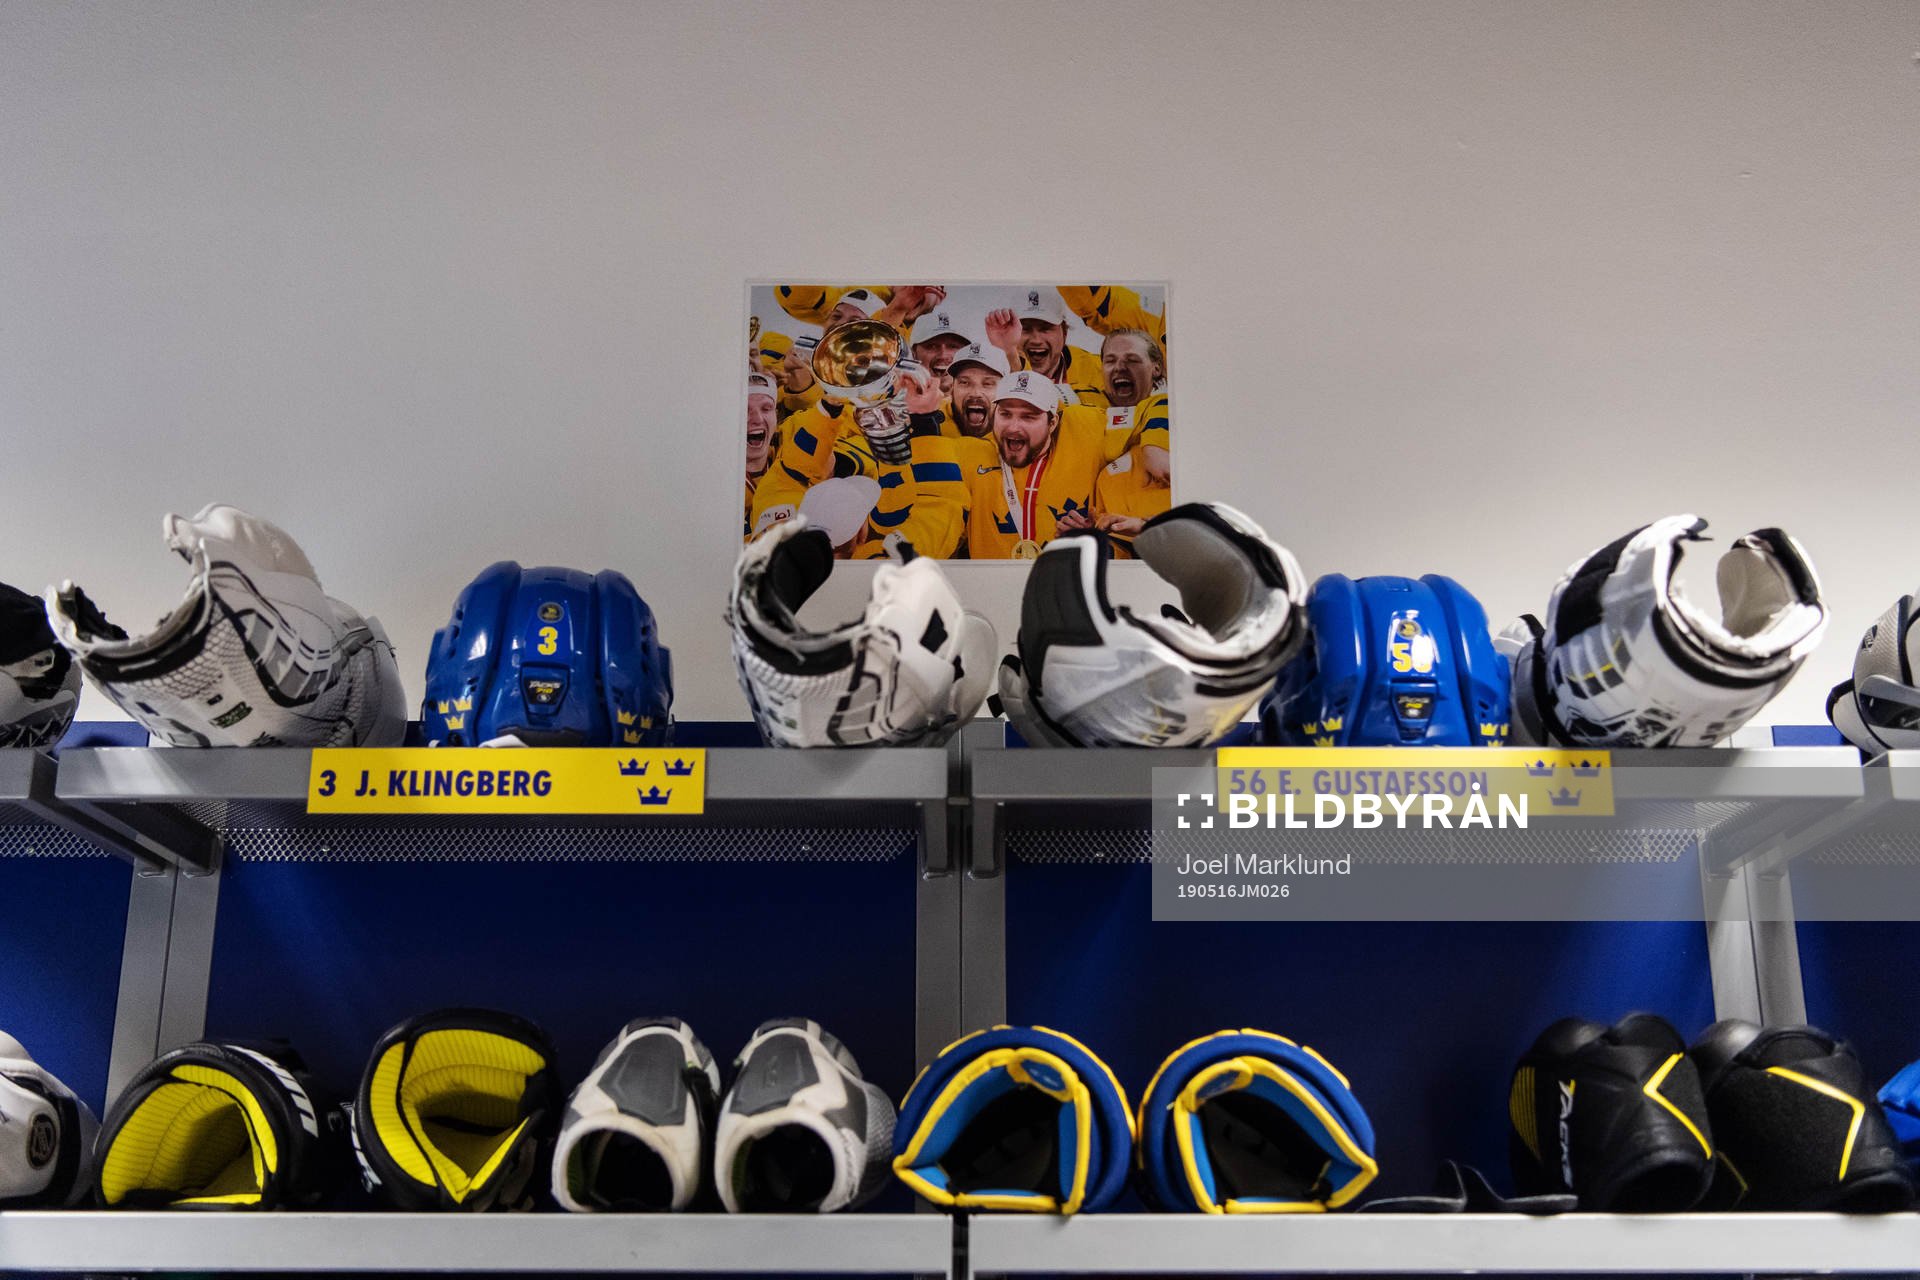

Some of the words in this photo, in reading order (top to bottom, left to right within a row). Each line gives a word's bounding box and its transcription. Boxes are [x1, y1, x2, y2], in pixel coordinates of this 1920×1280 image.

[538, 627, 558, 655] 3
[1393, 640, 1434, 673] 5
[318, 769, 337, 797] 3
[355, 769, 378, 797] J.
[388, 769, 552, 797] KLINGBERG
[1230, 769, 1267, 796] 56
[1279, 769, 1302, 796] E.
[1312, 769, 1489, 797] GUSTAFSSON
